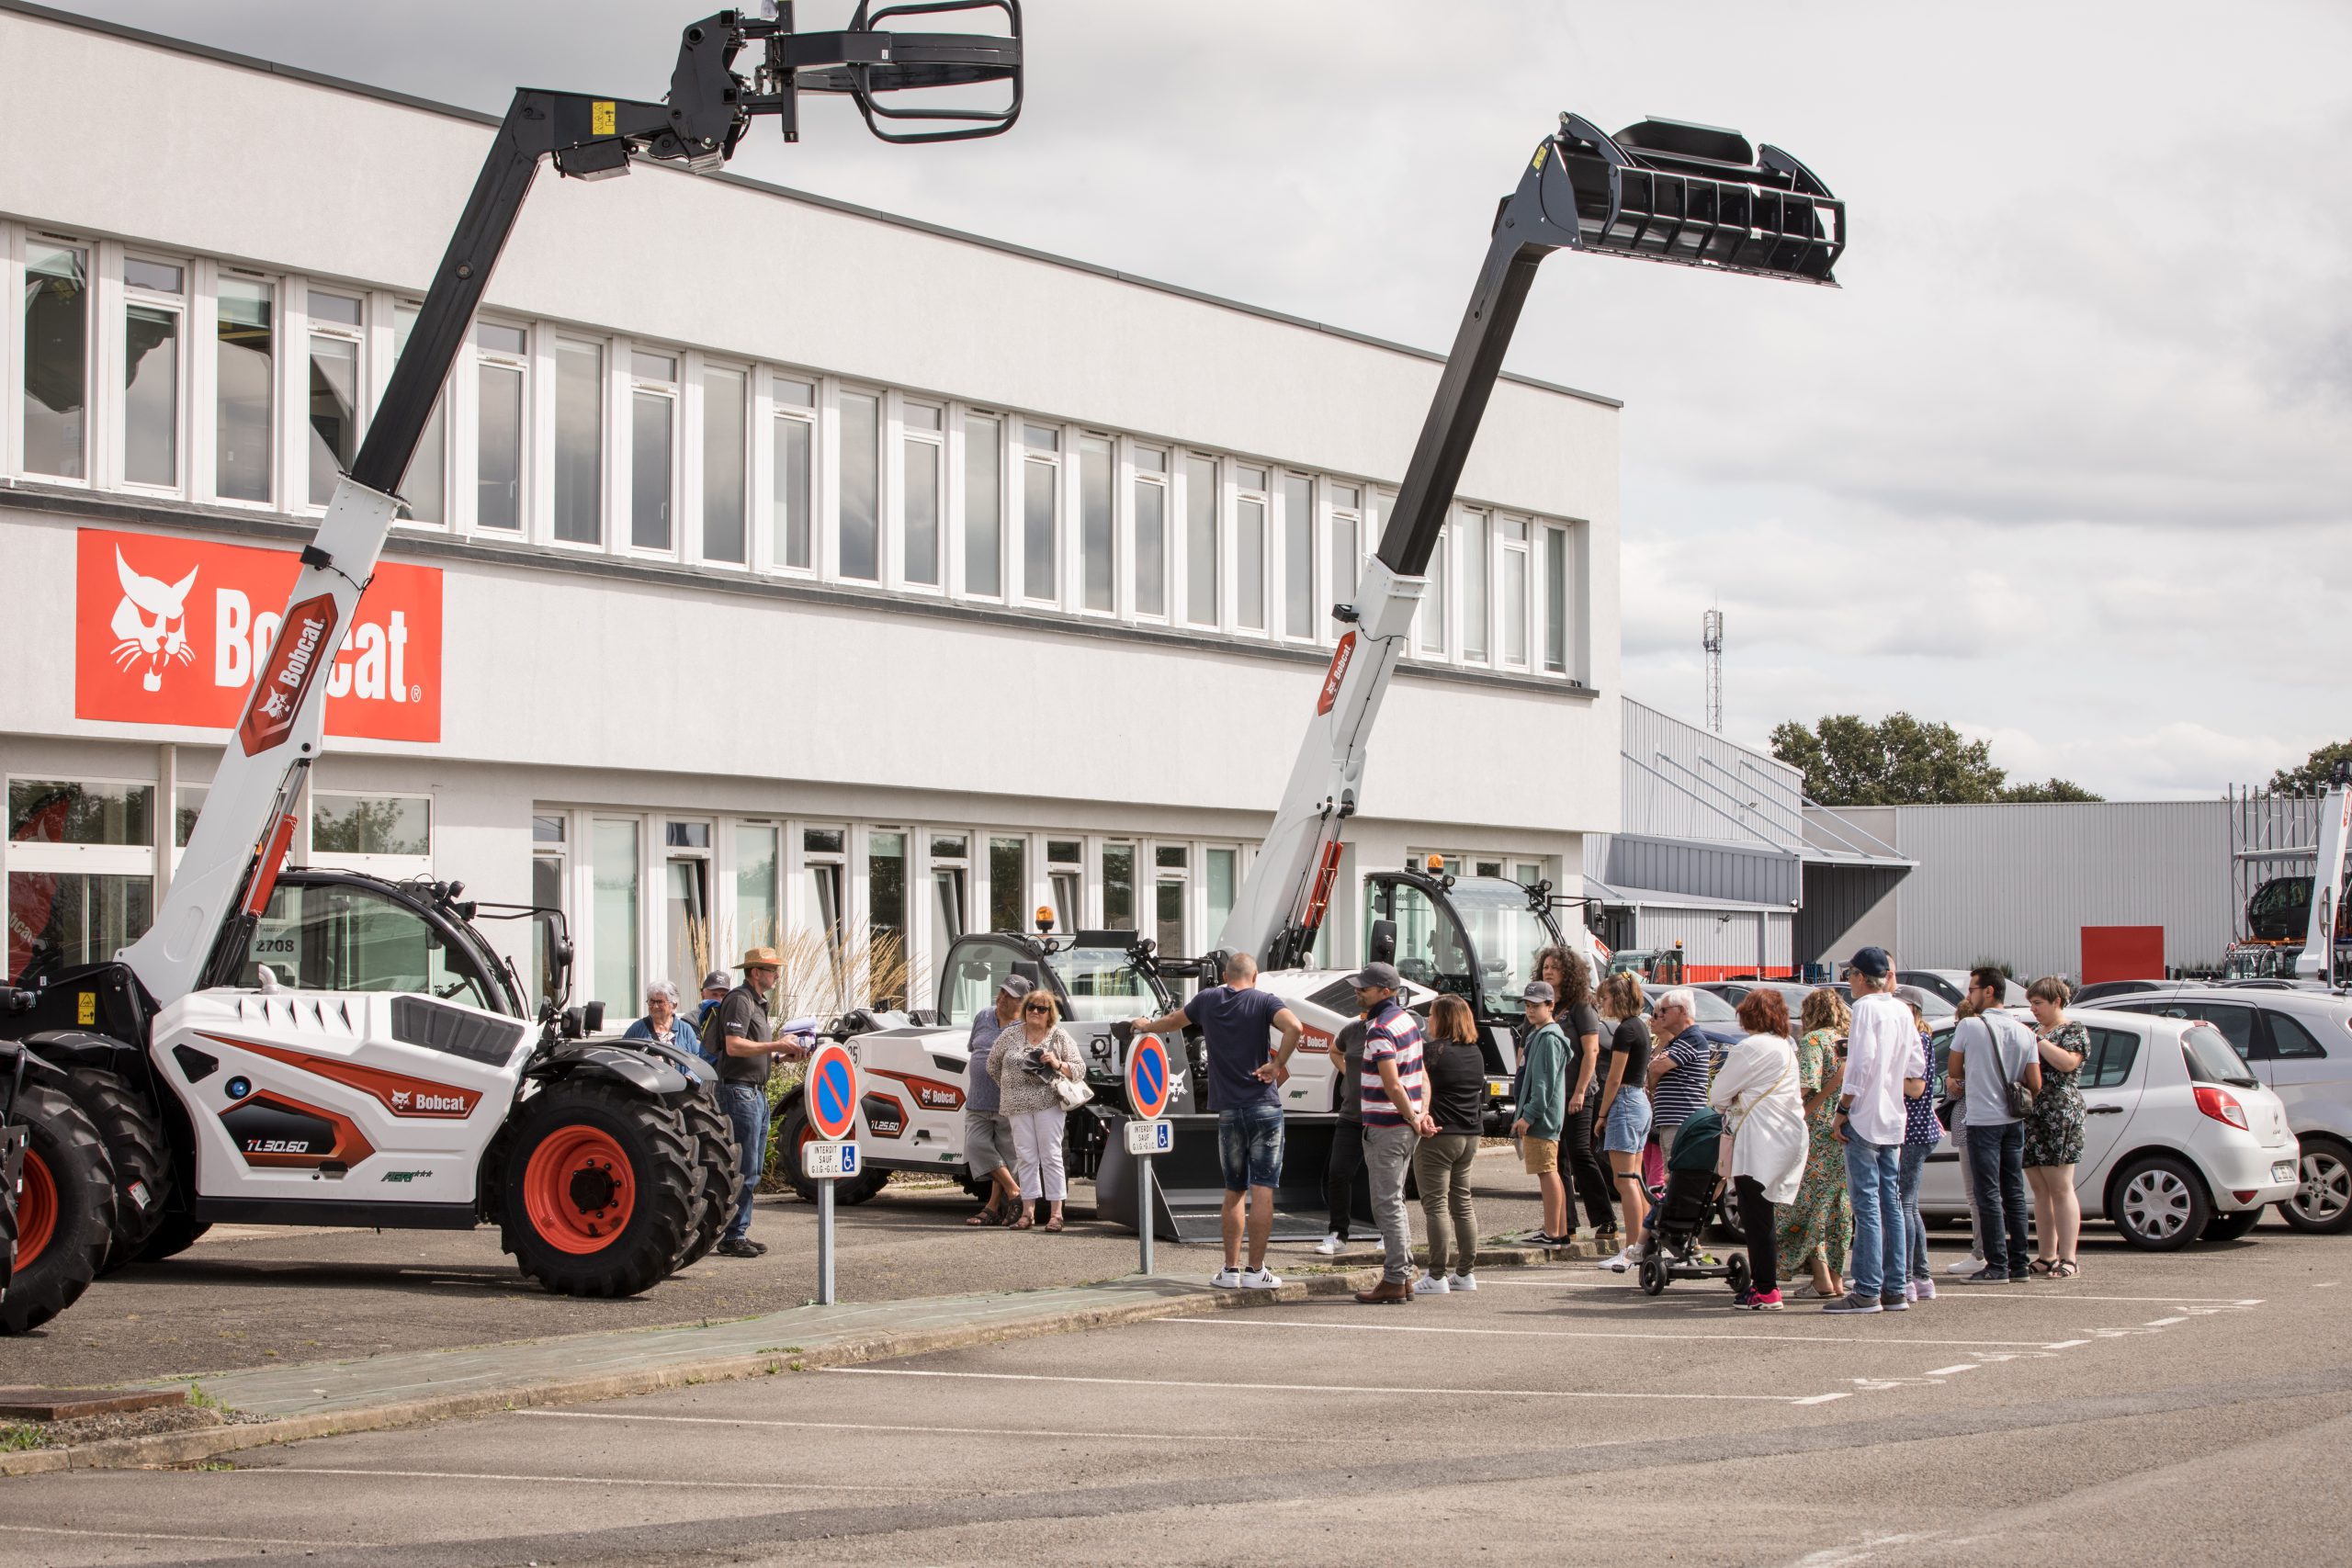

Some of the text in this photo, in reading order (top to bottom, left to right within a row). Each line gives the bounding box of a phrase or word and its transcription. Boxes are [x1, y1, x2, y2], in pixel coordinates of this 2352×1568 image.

[214, 588, 408, 703] Bocat
[278, 617, 324, 689] Bobcat
[1333, 644, 1351, 681] Bobcat
[255, 940, 294, 953] 2708
[1306, 1035, 1328, 1048] Bobcat
[416, 1094, 465, 1111] Bobcat
[933, 1090, 956, 1104] Bobcat
[871, 1120, 899, 1132] TL25.60
[1135, 1125, 1153, 1134] INTERDIT
[1138, 1134, 1149, 1142] SAUF
[246, 1139, 310, 1153] TL30.60
[814, 1145, 838, 1155] INTERDIT
[819, 1155, 832, 1164] SAUF
